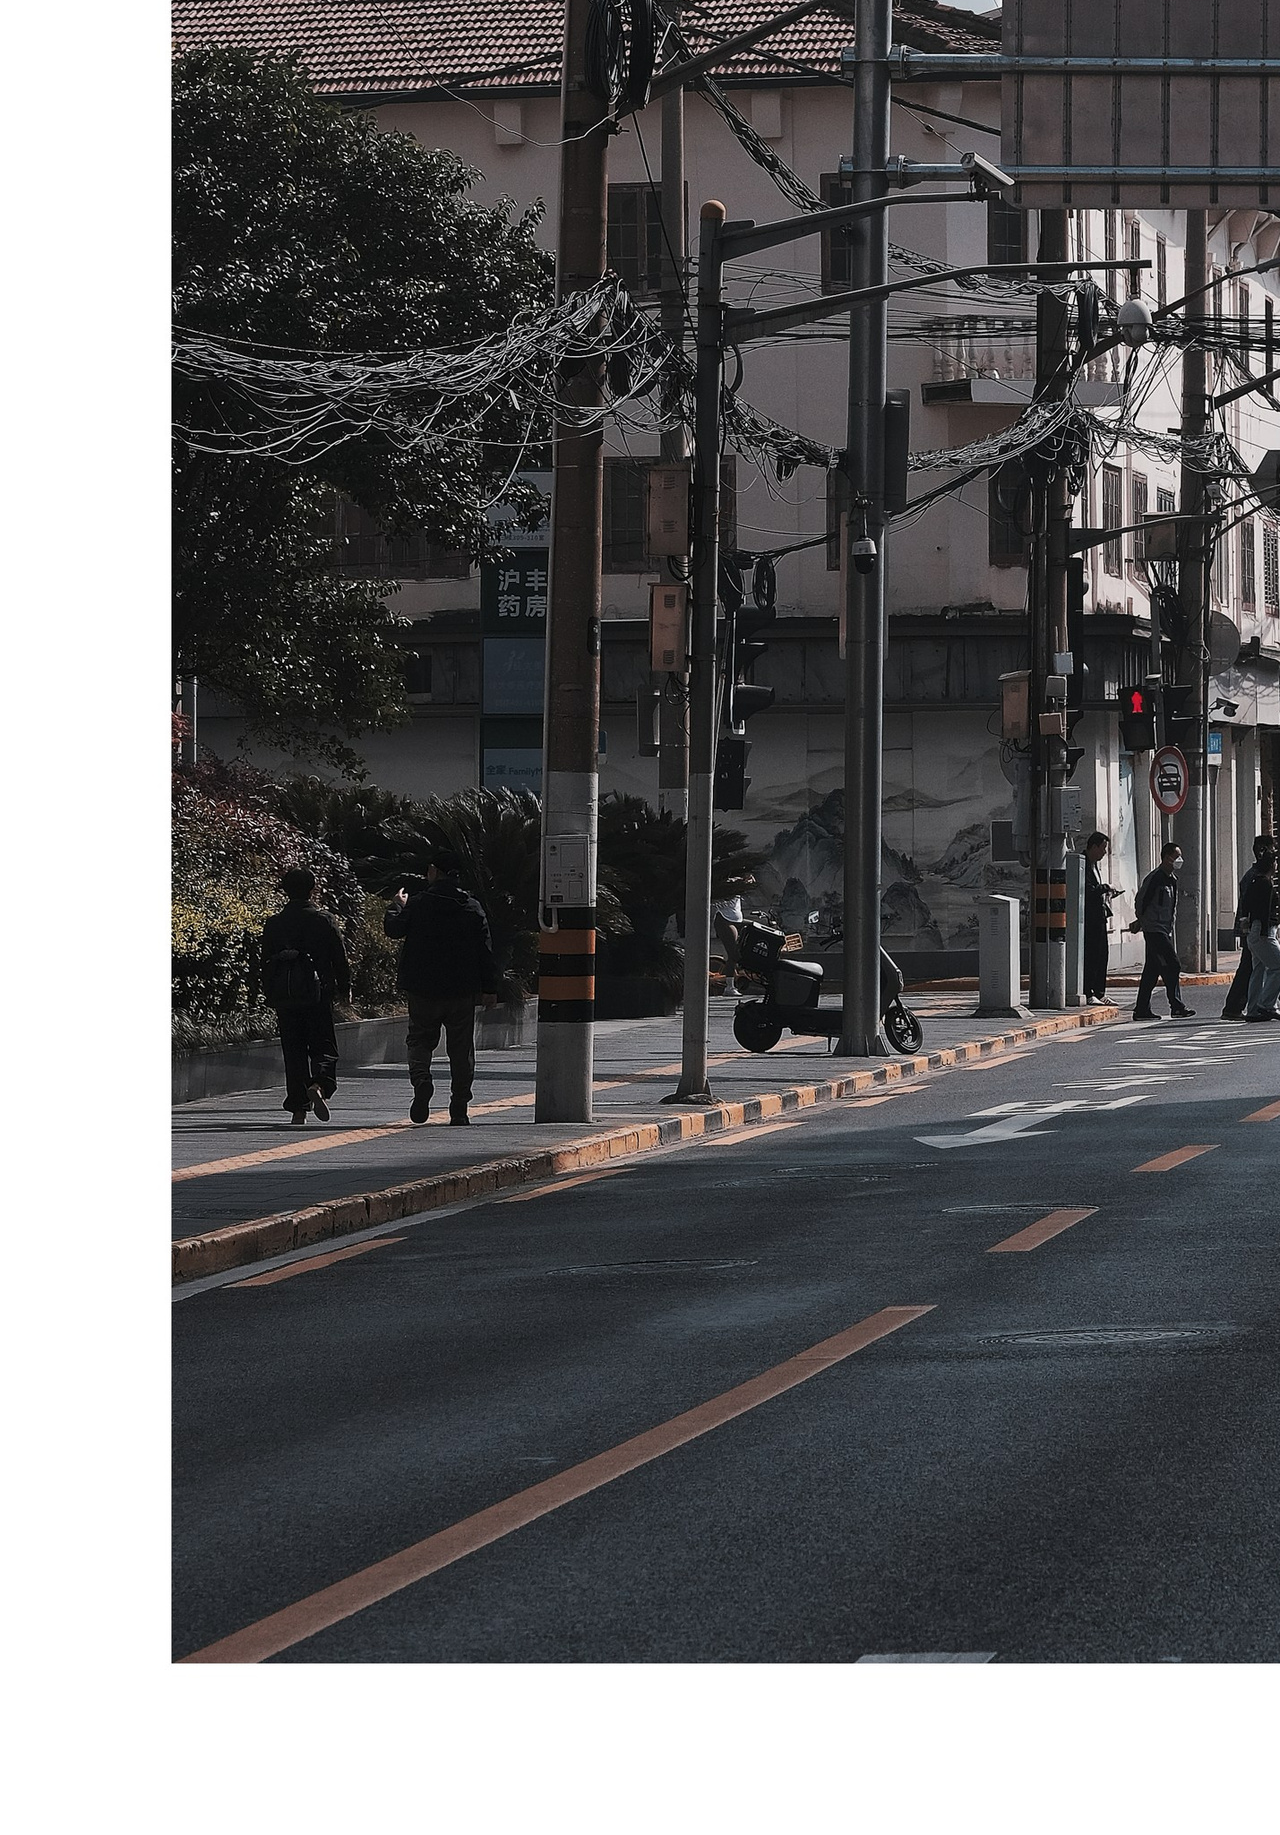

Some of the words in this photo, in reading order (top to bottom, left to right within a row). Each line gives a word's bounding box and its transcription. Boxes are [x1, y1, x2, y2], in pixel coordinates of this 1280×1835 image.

[497, 568, 548, 592] 沪丰
[497, 594, 548, 618] 药房
[486, 765, 507, 776] 全家
